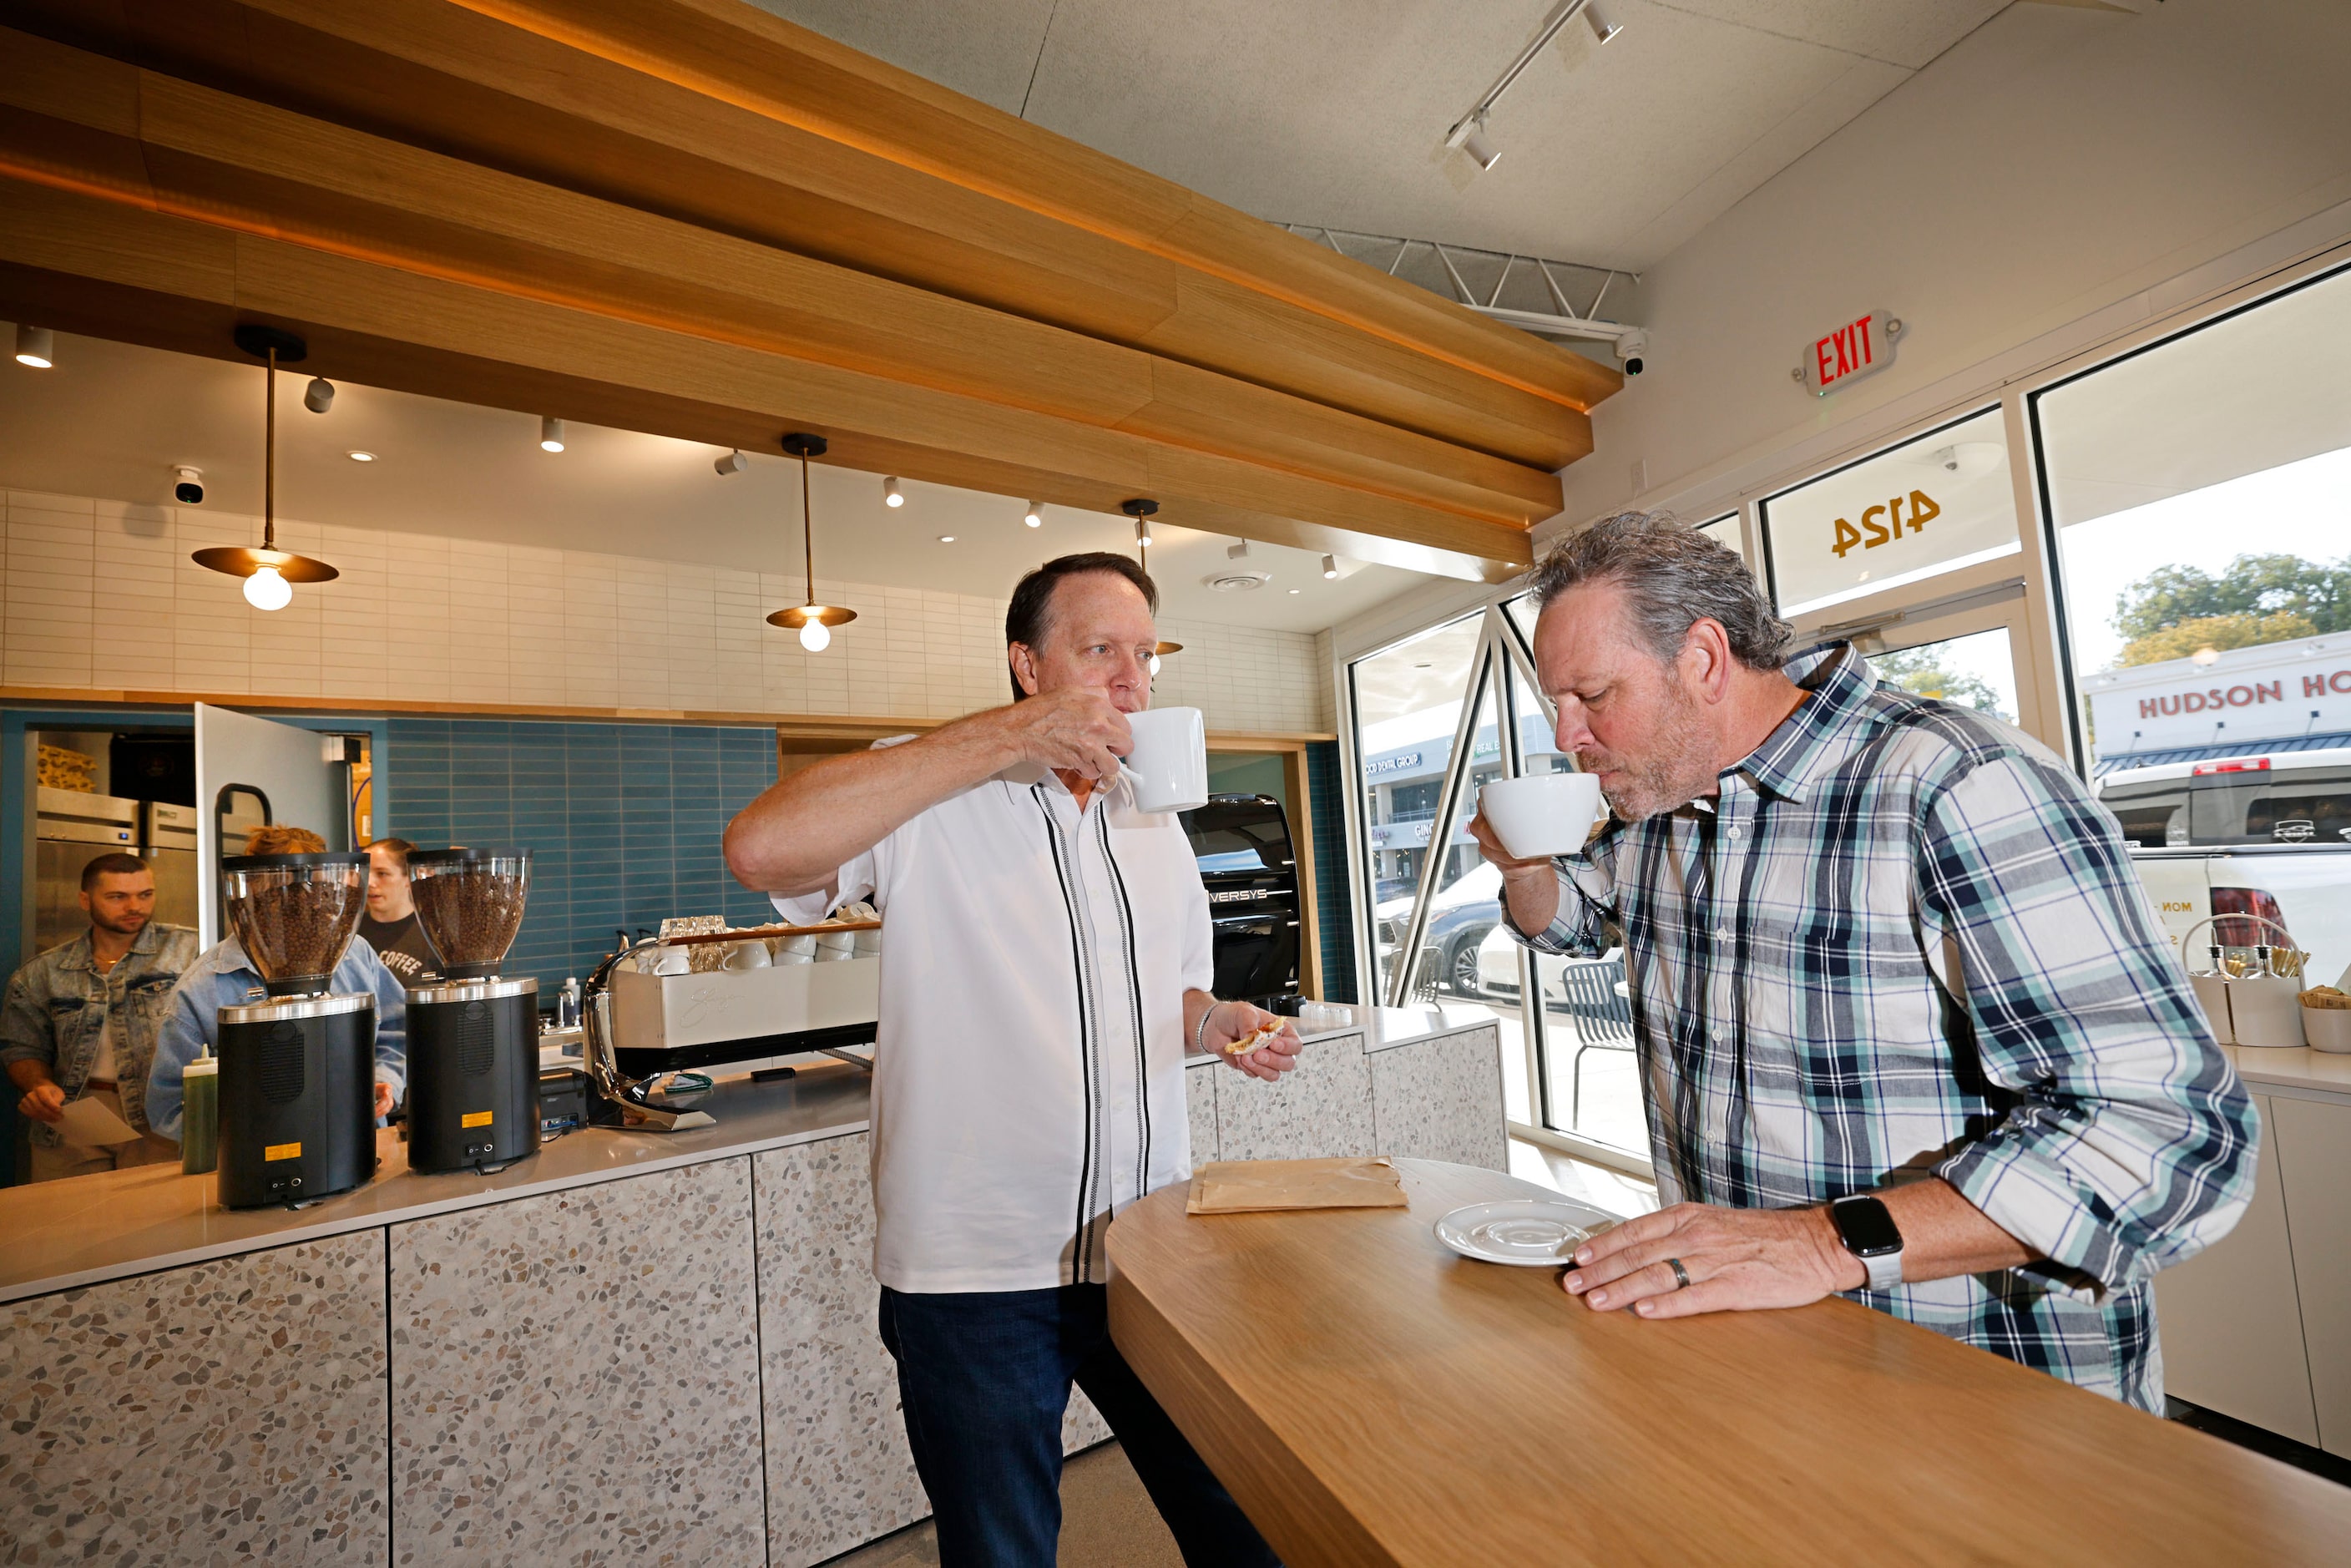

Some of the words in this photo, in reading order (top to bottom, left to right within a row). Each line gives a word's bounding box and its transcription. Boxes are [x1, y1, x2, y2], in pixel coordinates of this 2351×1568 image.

[1816, 315, 1872, 386] EXIT
[2139, 680, 2283, 719] HUDSON
[1476, 741, 1493, 753] REAL
[1378, 758, 1397, 772] DENTAL
[1397, 753, 1418, 768] GROUP
[378, 949, 423, 977] COFFEE
